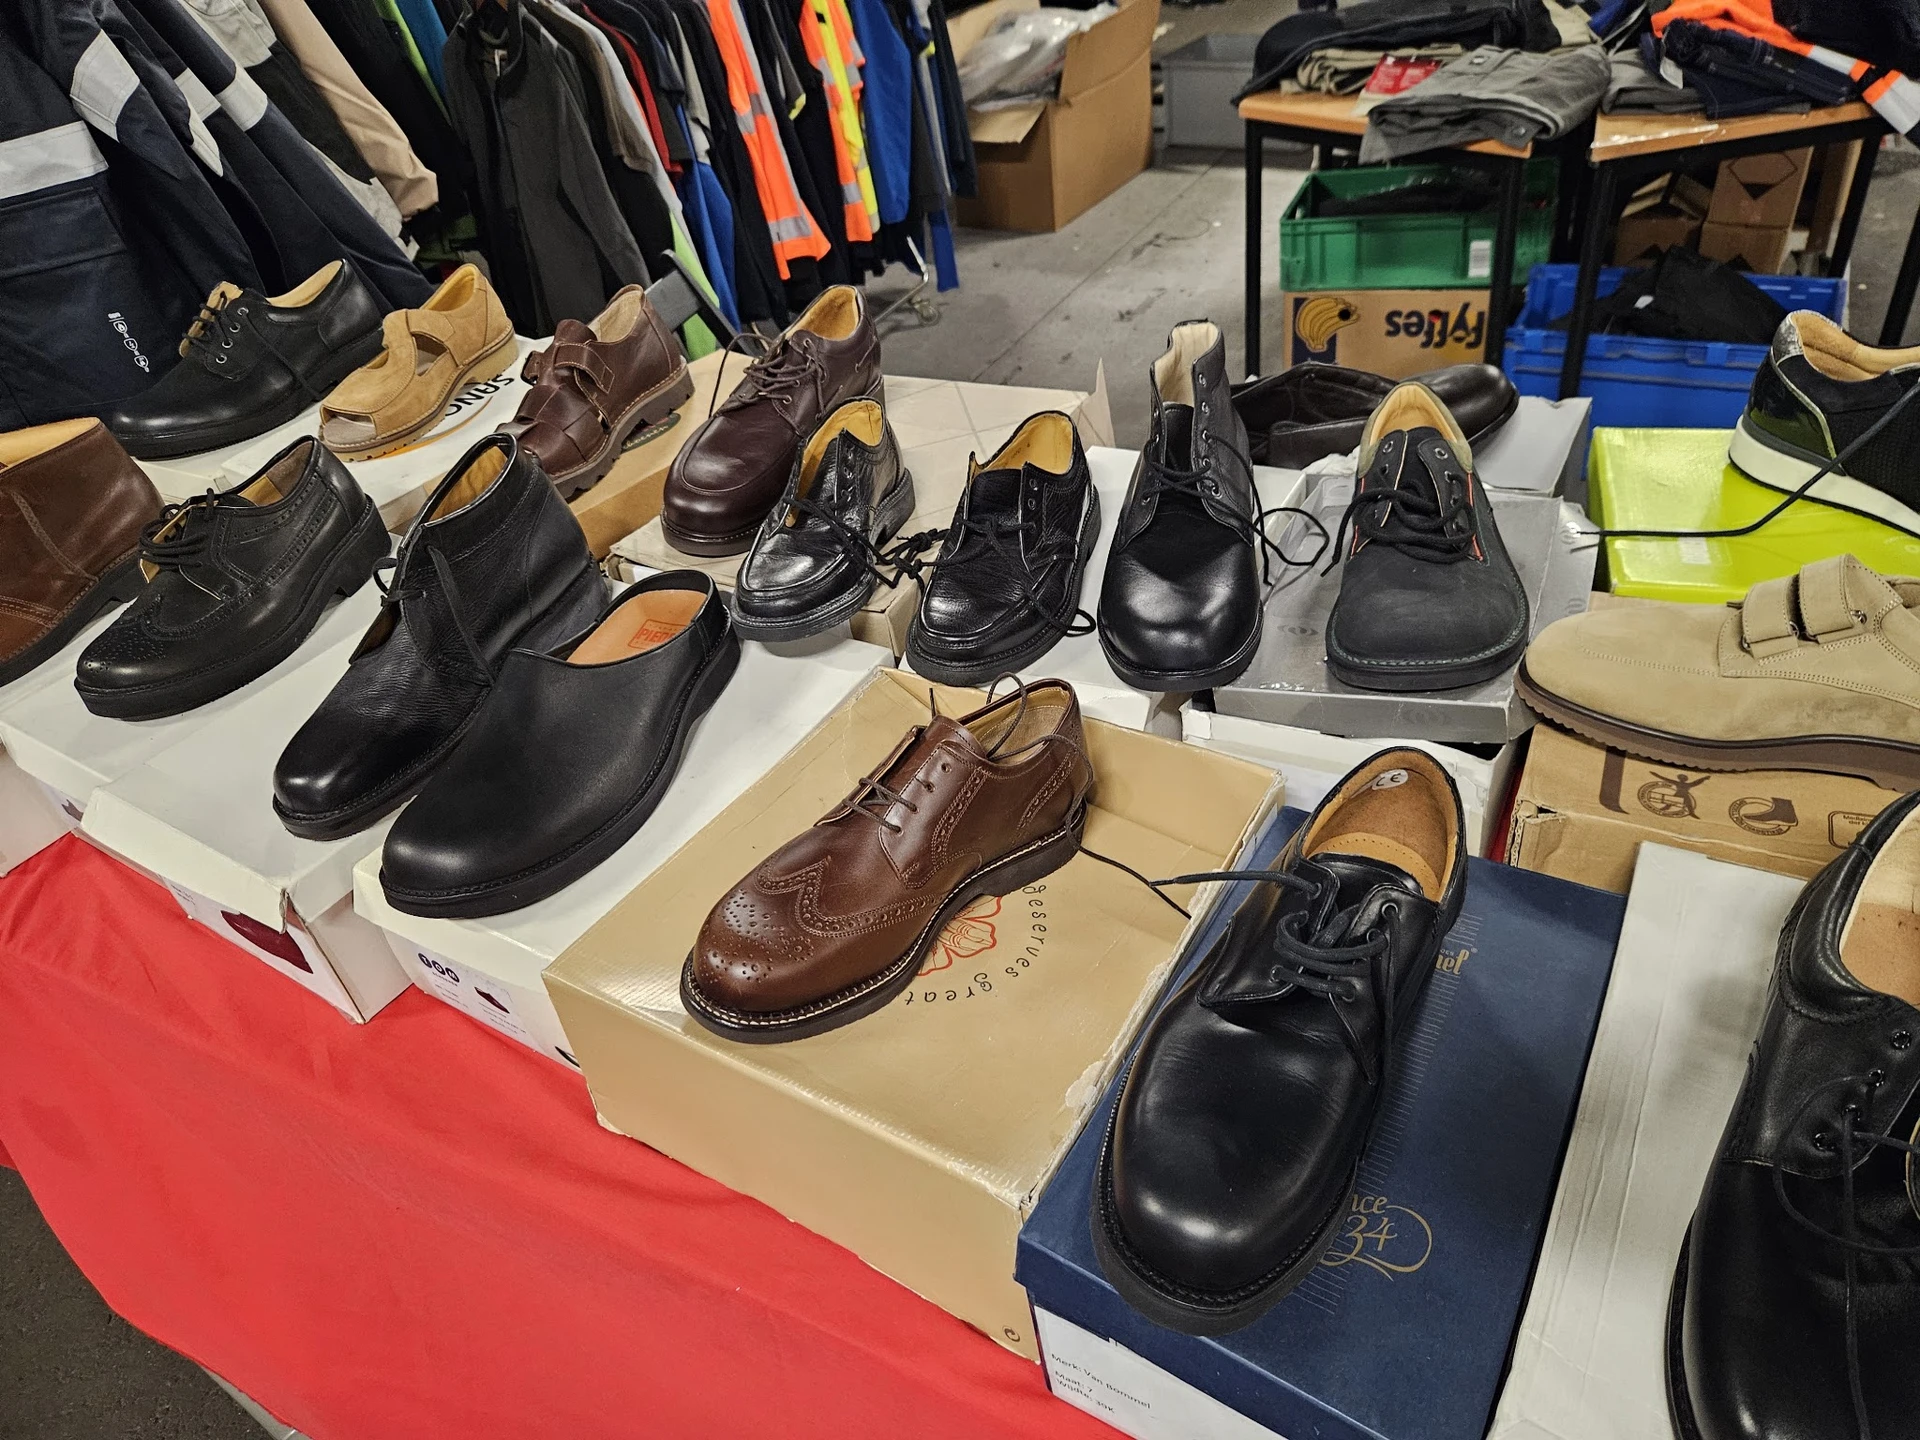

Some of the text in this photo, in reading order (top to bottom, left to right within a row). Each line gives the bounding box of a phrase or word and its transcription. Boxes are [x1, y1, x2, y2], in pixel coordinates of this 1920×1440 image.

[1376, 773, 1401, 787] CE
[1004, 884, 1047, 978] deserves
[904, 972, 993, 1006] great
[1051, 1353, 1151, 1409] Merk: Van Bommel
[1055, 1370, 1085, 1390] Maat:
